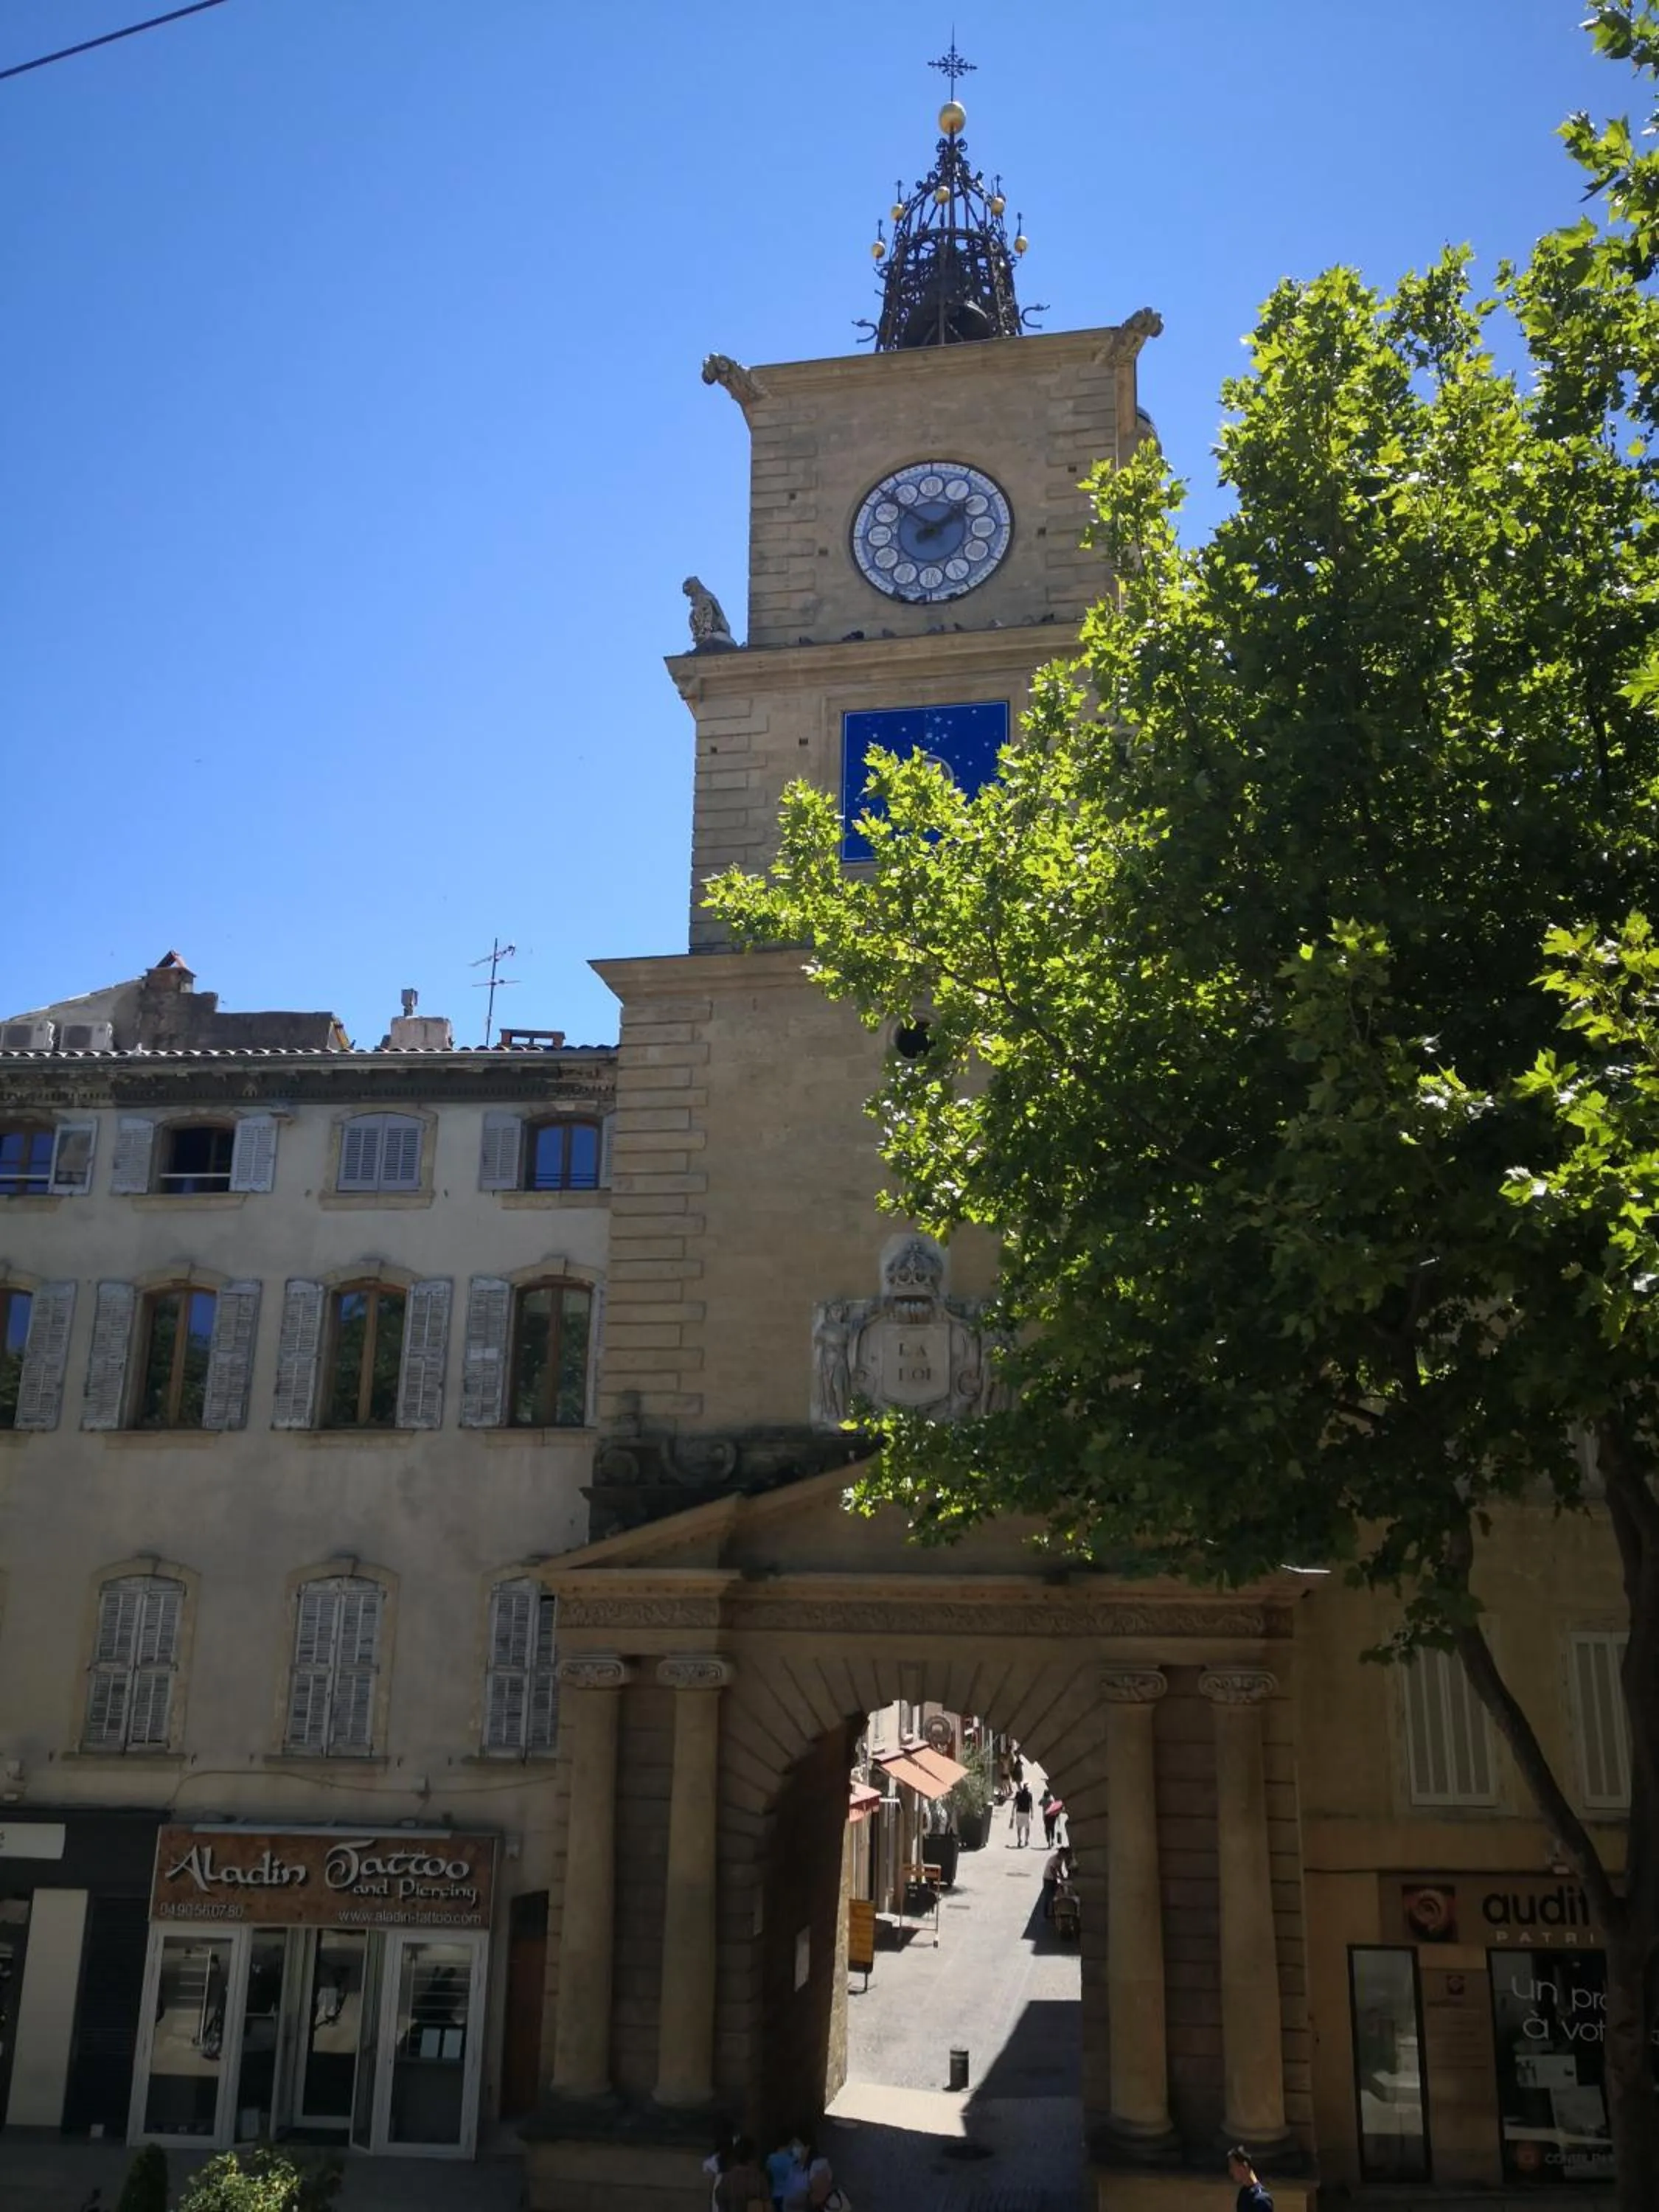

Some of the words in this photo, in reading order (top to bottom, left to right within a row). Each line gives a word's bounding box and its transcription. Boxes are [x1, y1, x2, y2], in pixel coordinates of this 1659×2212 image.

[165, 1844, 308, 1893] Aladin
[324, 1839, 470, 1890] Tattoo
[352, 1881, 389, 1897] and
[399, 1879, 479, 1906] Piercing
